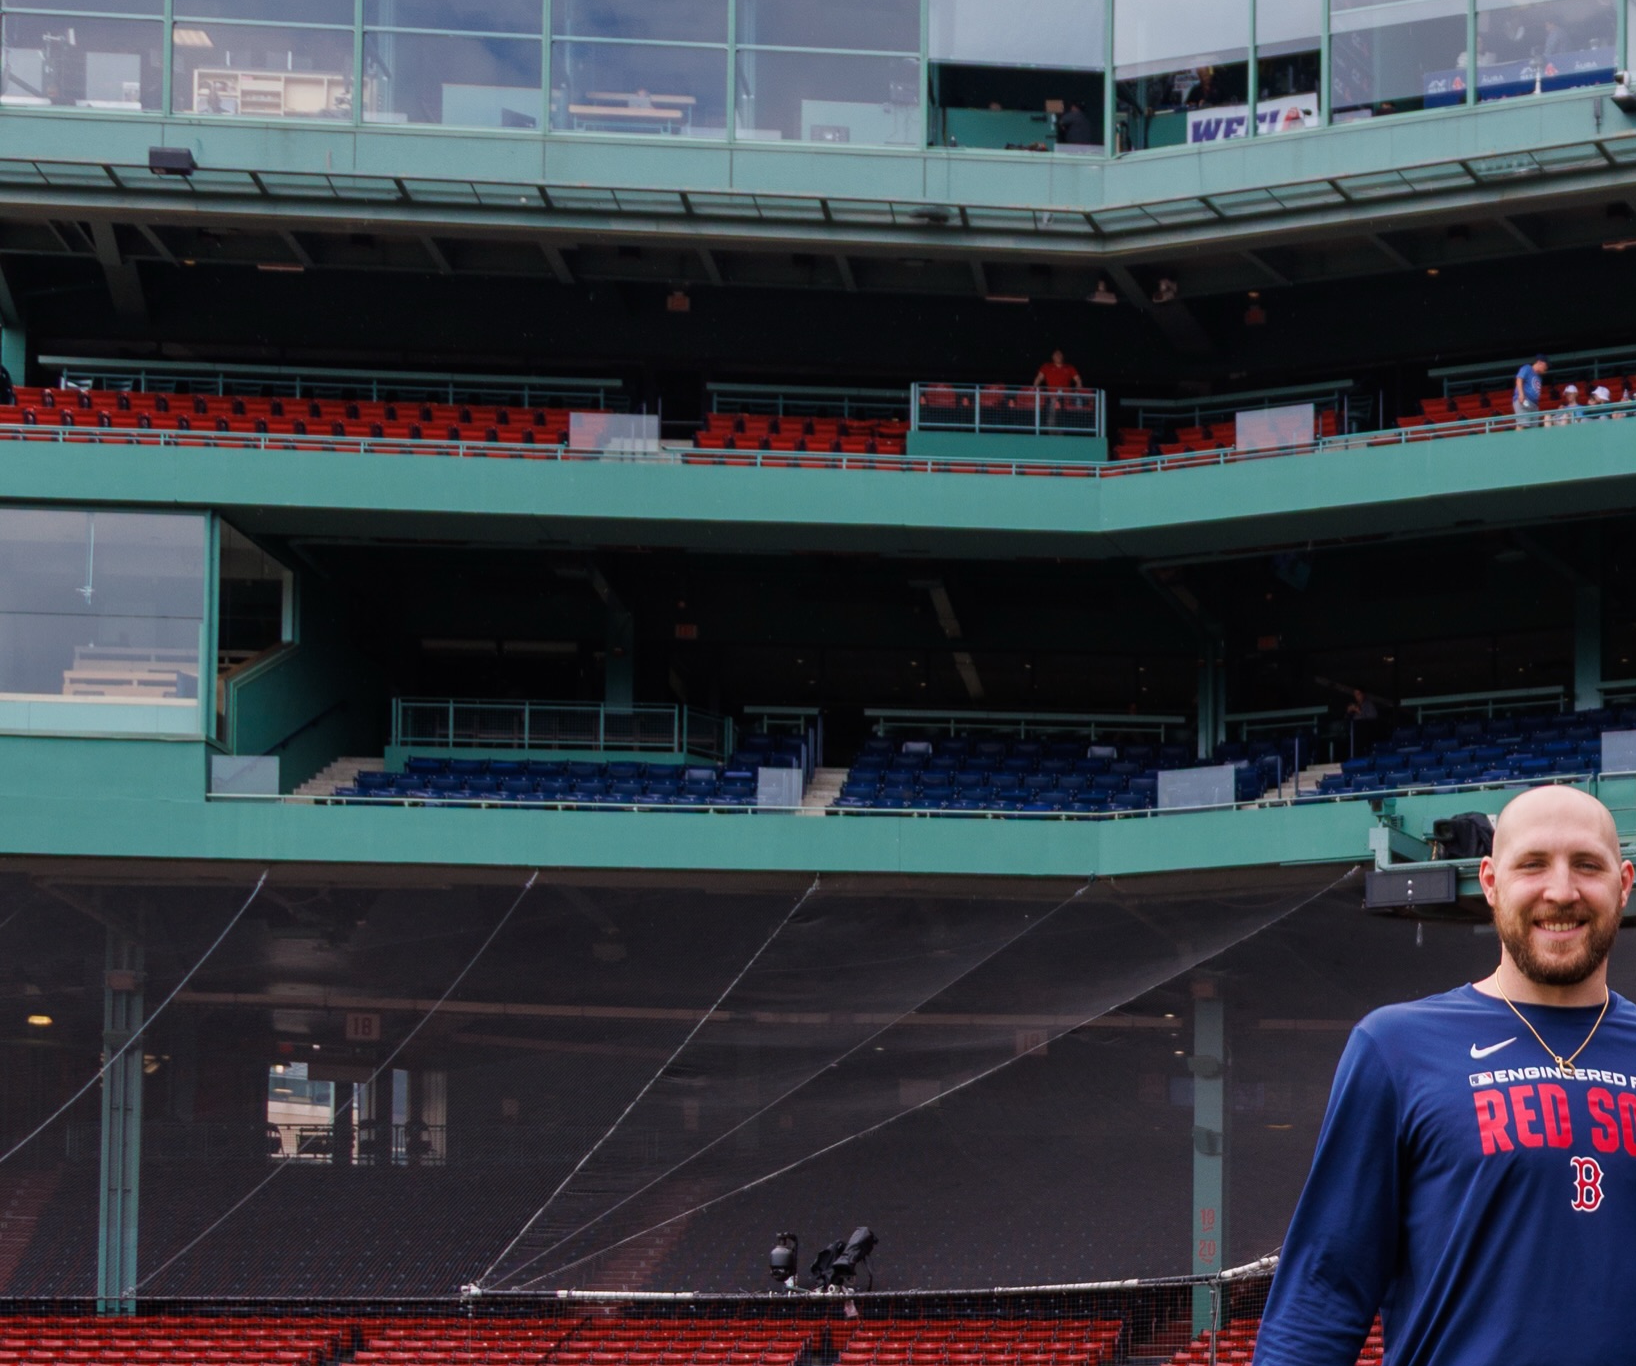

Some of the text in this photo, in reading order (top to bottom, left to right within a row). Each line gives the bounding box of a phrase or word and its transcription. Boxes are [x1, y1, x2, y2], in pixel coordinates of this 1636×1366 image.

[354, 1017, 372, 1036] 18
[1473, 1083, 1573, 1155] RED
[1570, 1156, 1604, 1212] B
[1198, 1240, 1216, 1257] 20
